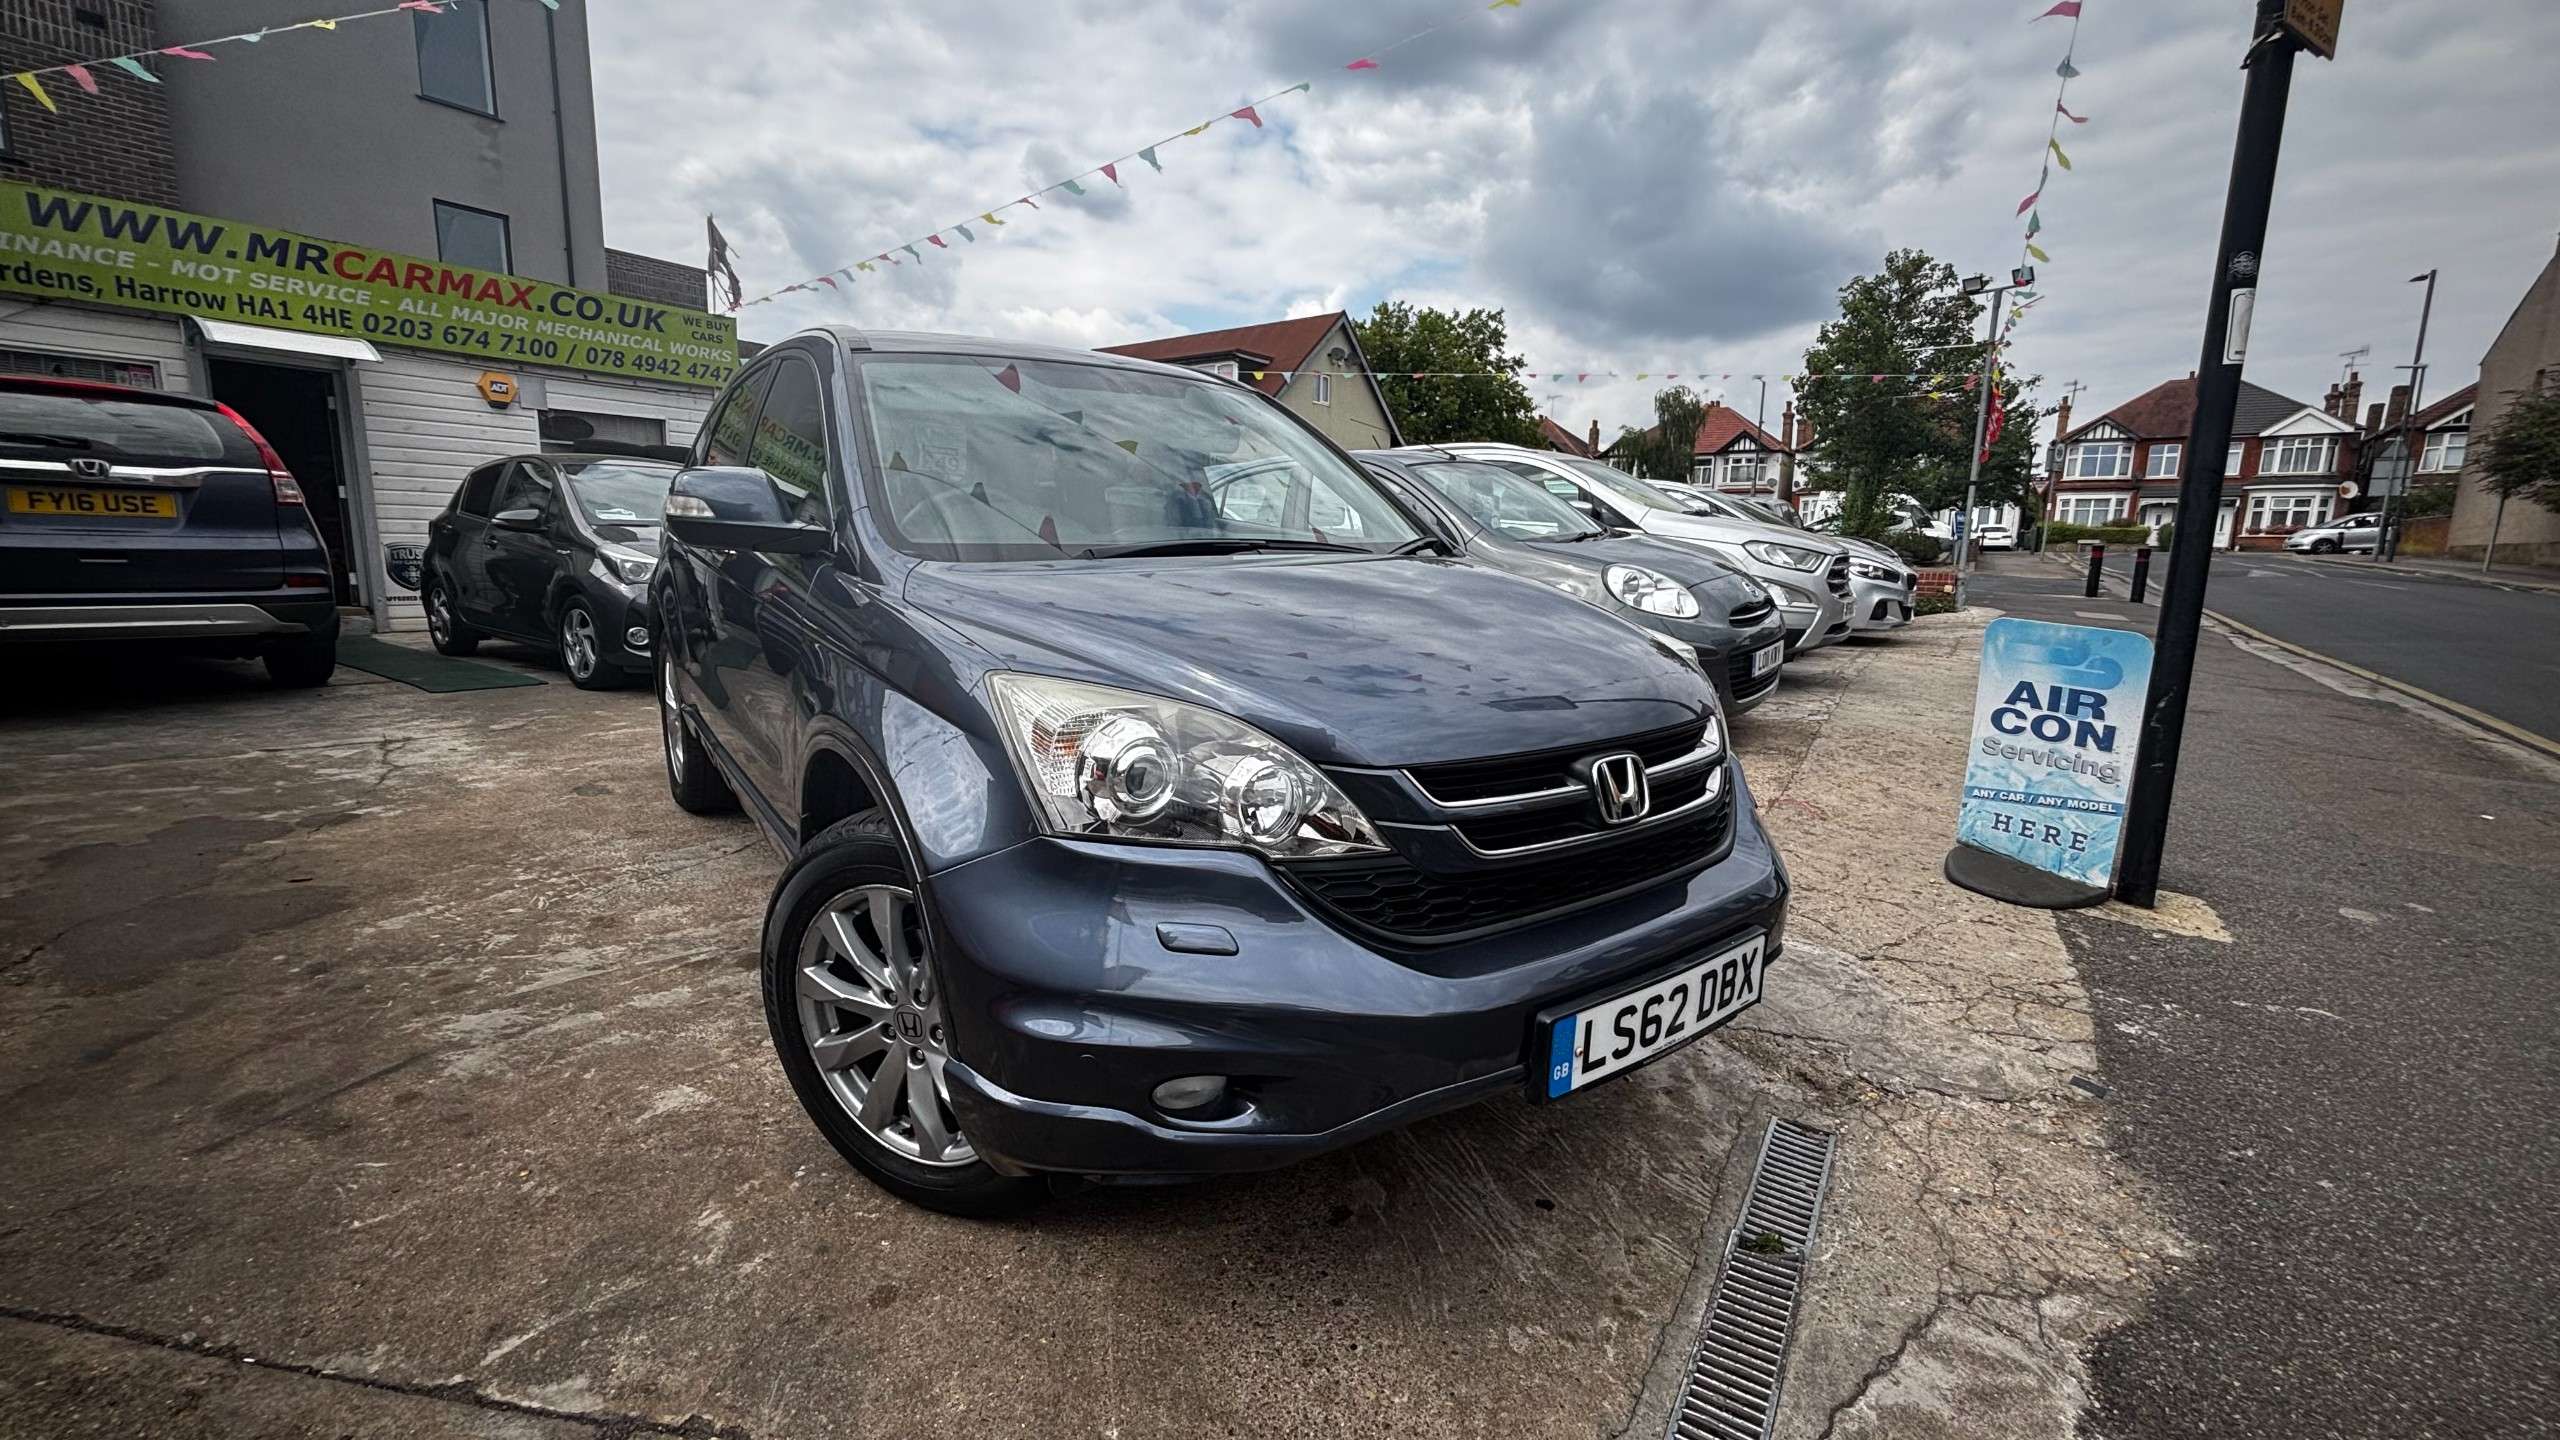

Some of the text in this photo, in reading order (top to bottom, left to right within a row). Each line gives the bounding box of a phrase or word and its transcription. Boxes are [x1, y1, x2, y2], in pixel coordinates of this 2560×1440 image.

[25, 191, 666, 334] WWW.MRCARMAX.CO.UK
[0, 231, 137, 269] INANCE
[171, 259, 241, 284] MOT
[249, 272, 372, 306] SERVICE
[398, 297, 443, 319] ALL
[451, 305, 529, 331] MAJOR
[535, 321, 664, 353] MECHANICAL
[670, 342, 732, 362] WORKS
[0, 261, 104, 299] rdens,
[115, 275, 226, 312] Harrow
[236, 293, 293, 321] HA1
[302, 305, 354, 331] 4HE
[362, 313, 433, 342] 0203
[442, 325, 491, 350] 674
[500, 332, 558, 359] 7100
[586, 348, 625, 368] 078
[631, 353, 680, 377] 4942
[687, 362, 734, 382] 4747
[682, 315, 730, 332] WE BUY
[691, 331, 723, 344] CARS
[28, 490, 160, 514] FY16 USE
[392, 549, 423, 559] TRUS
[2003, 680, 2109, 722] AIR
[1990, 707, 2117, 753] CON
[1981, 736, 2121, 785] Servicing
[1971, 788, 1996, 800] ANY
[2000, 791, 2025, 803] CAR
[2037, 795, 2065, 808] ANY
[2067, 799, 2117, 814] MODEL
[1991, 812, 2089, 853] HERE
[1581, 947, 1759, 1075] LS62 DBX
[1553, 1063, 1569, 1081] GB
